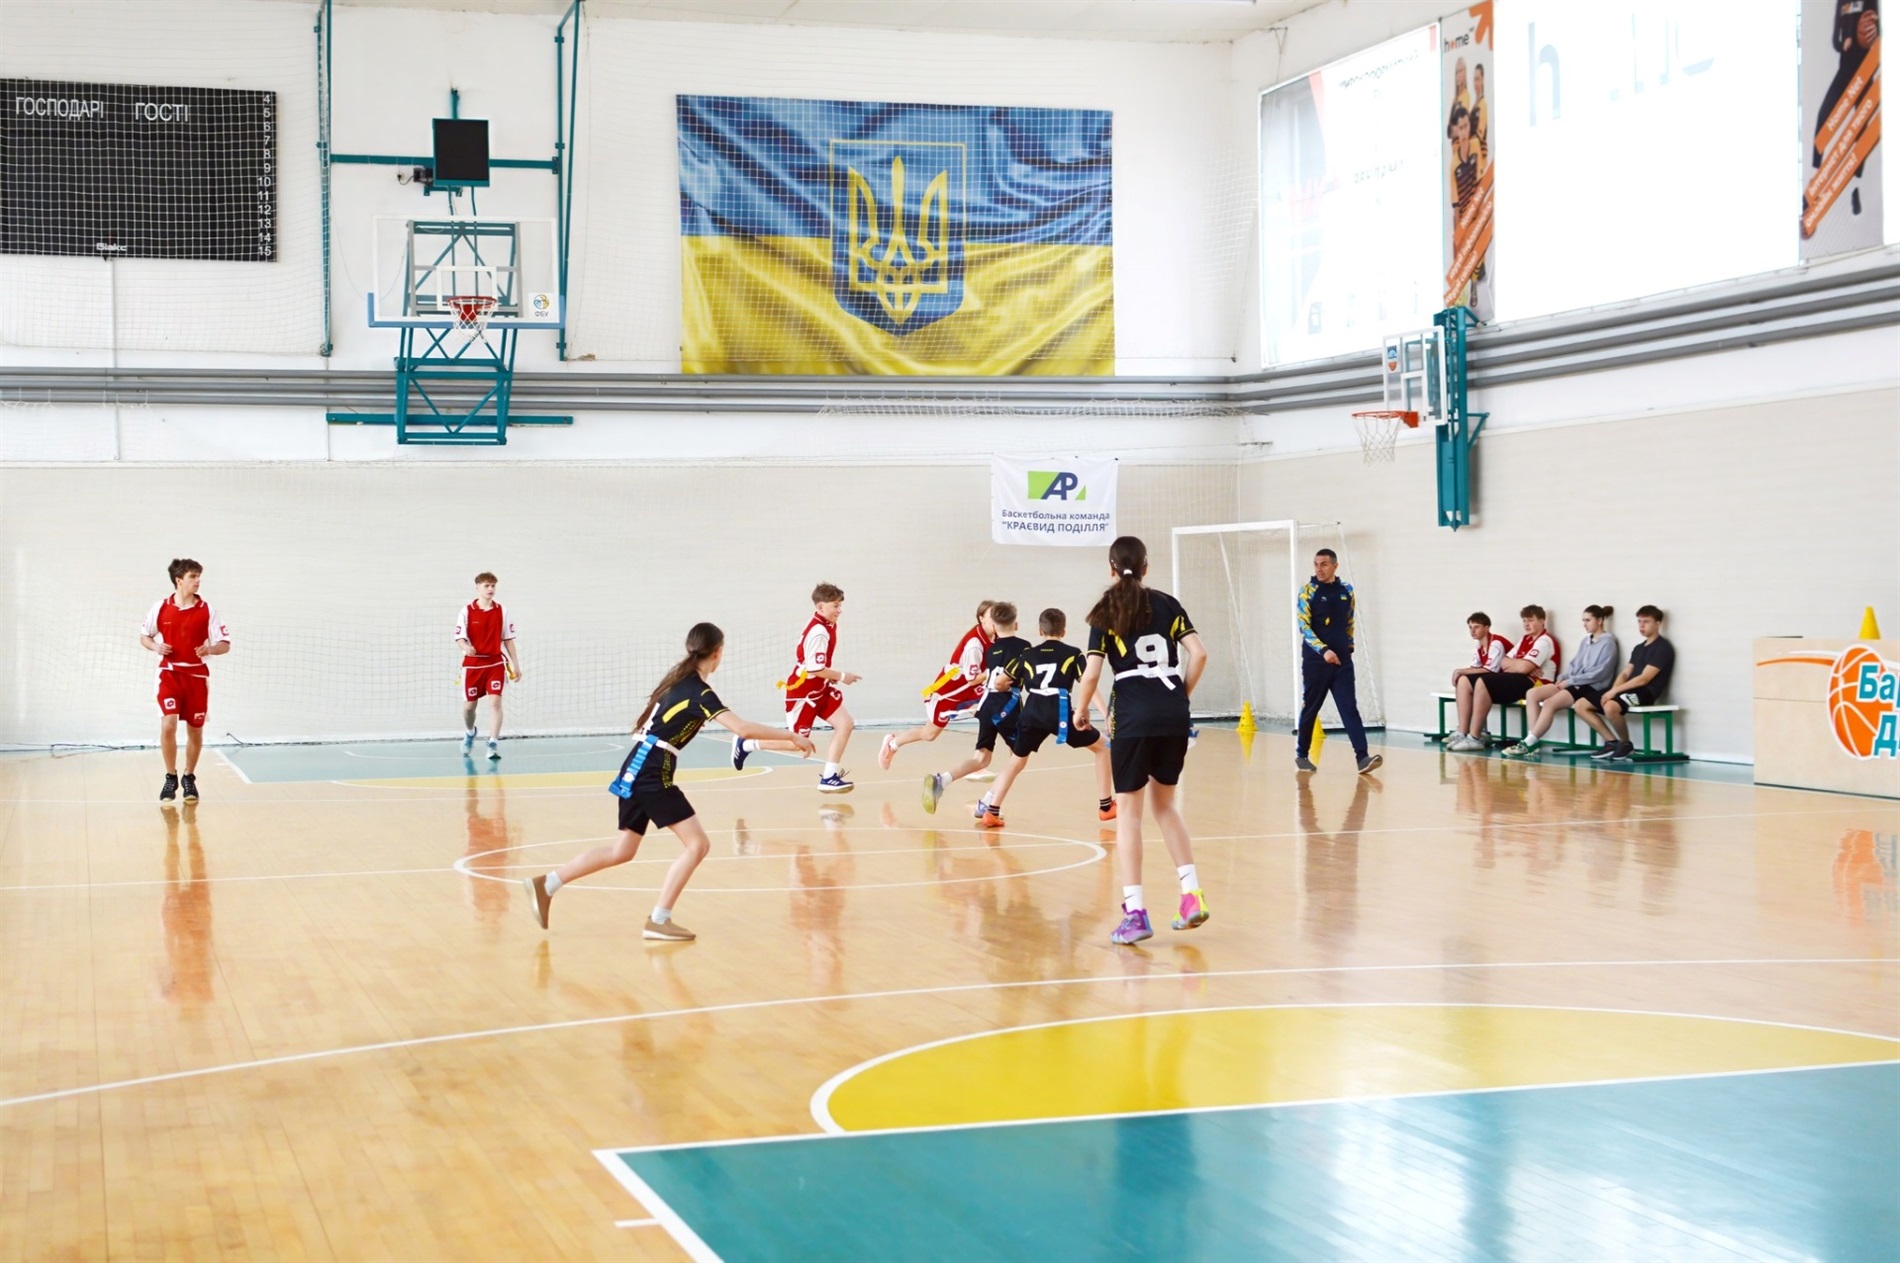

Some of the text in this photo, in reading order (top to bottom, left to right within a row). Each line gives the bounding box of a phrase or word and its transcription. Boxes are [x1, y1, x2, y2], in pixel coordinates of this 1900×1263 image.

[263, 94, 270, 104] 4
[15, 97, 104, 120] ГОСПОДАРІ
[135, 103, 188, 122] ГОСТІ
[263, 108, 270, 118] 5
[263, 121, 270, 132] 6
[264, 135, 270, 145] 7
[263, 149, 270, 159] 8
[264, 162, 271, 173] 9
[258, 176, 271, 187] 10
[258, 191, 269, 200] 11
[258, 205, 271, 215] 12
[258, 218, 271, 229] 13
[258, 232, 271, 243] 14
[258, 246, 271, 256] 15
[1002, 509, 1110, 521] Баскетбольна команда
[1134, 633, 1169, 670] 9
[1036, 663, 1057, 690] 7
[1859, 664, 1900, 708] Ба
[1873, 715, 1900, 757] Д
